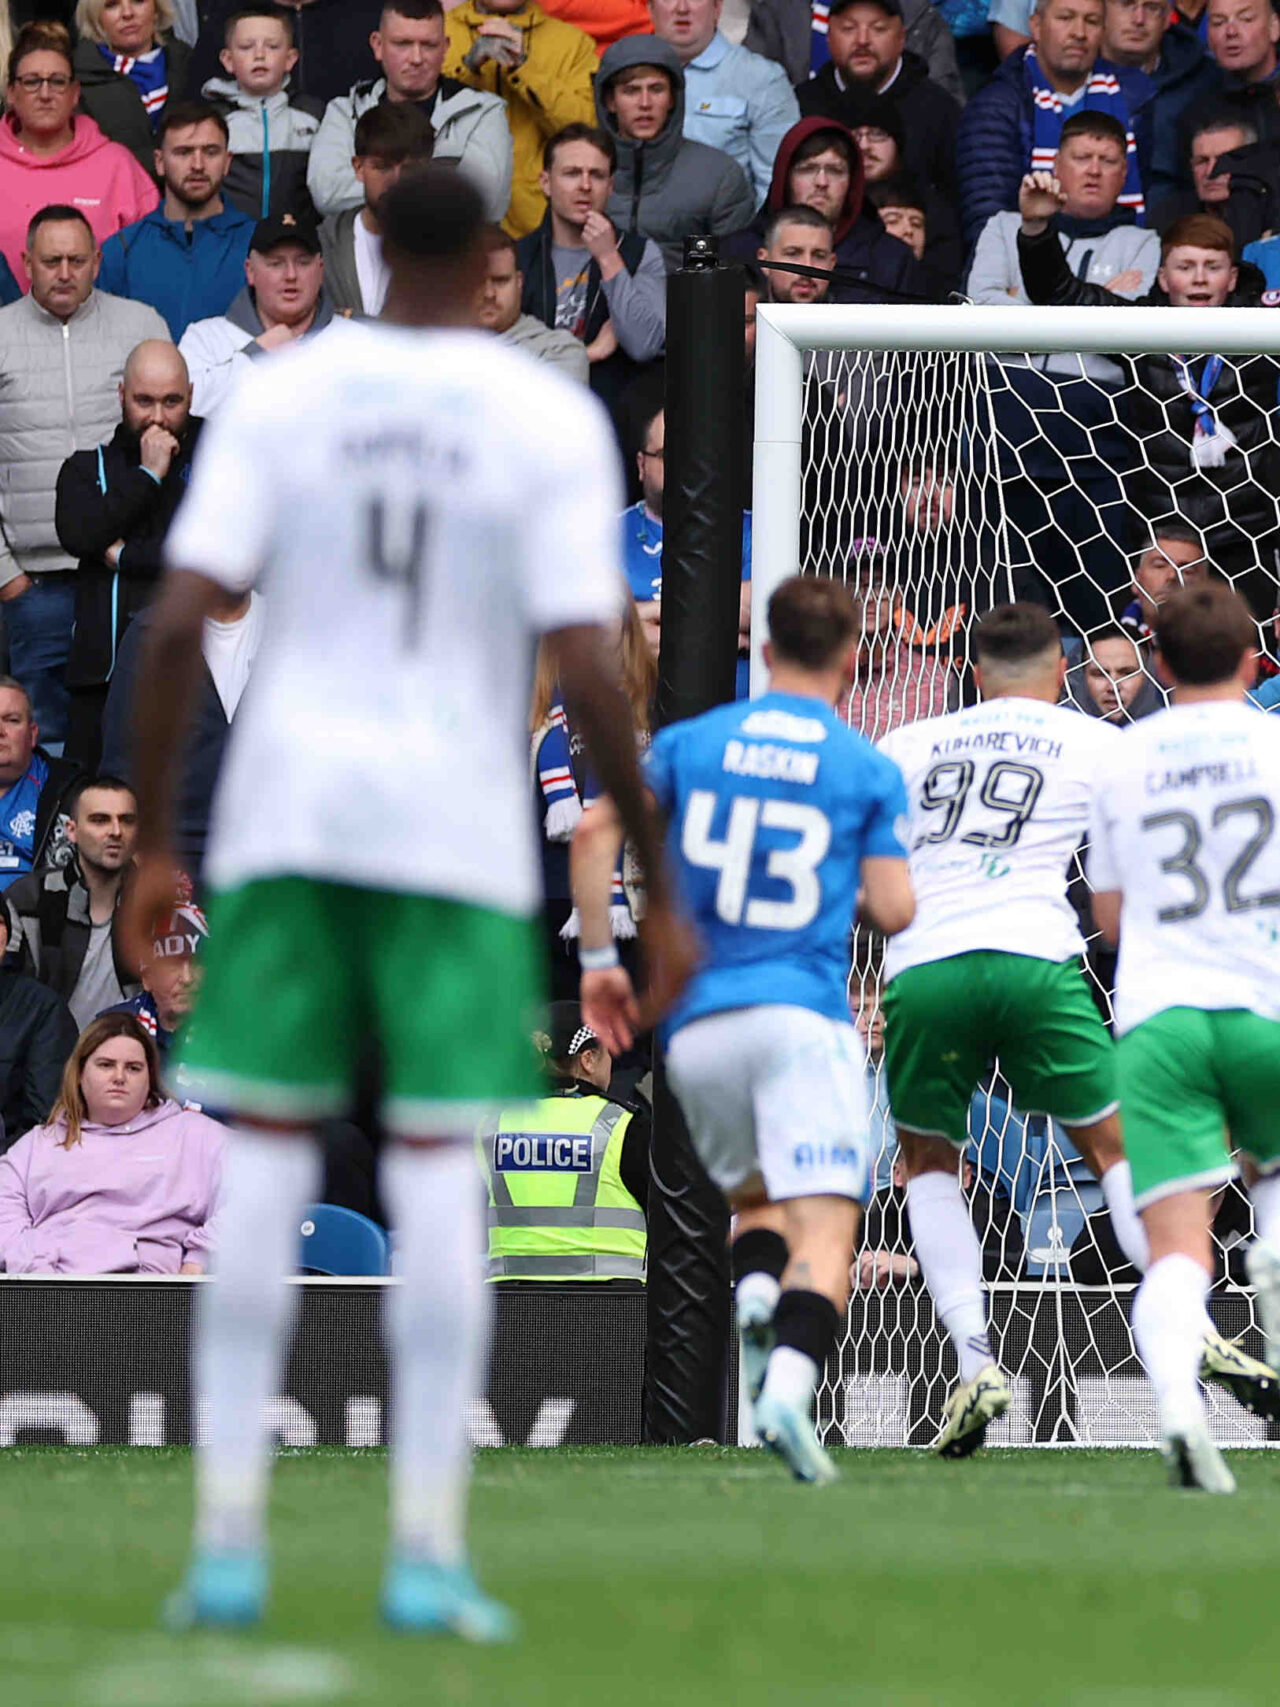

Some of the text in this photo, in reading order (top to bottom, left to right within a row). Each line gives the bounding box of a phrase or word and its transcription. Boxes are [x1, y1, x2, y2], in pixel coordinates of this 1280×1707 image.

[912, 759, 1044, 851] 99
[681, 789, 832, 931] 43
[497, 1137, 588, 1167] POLICE
